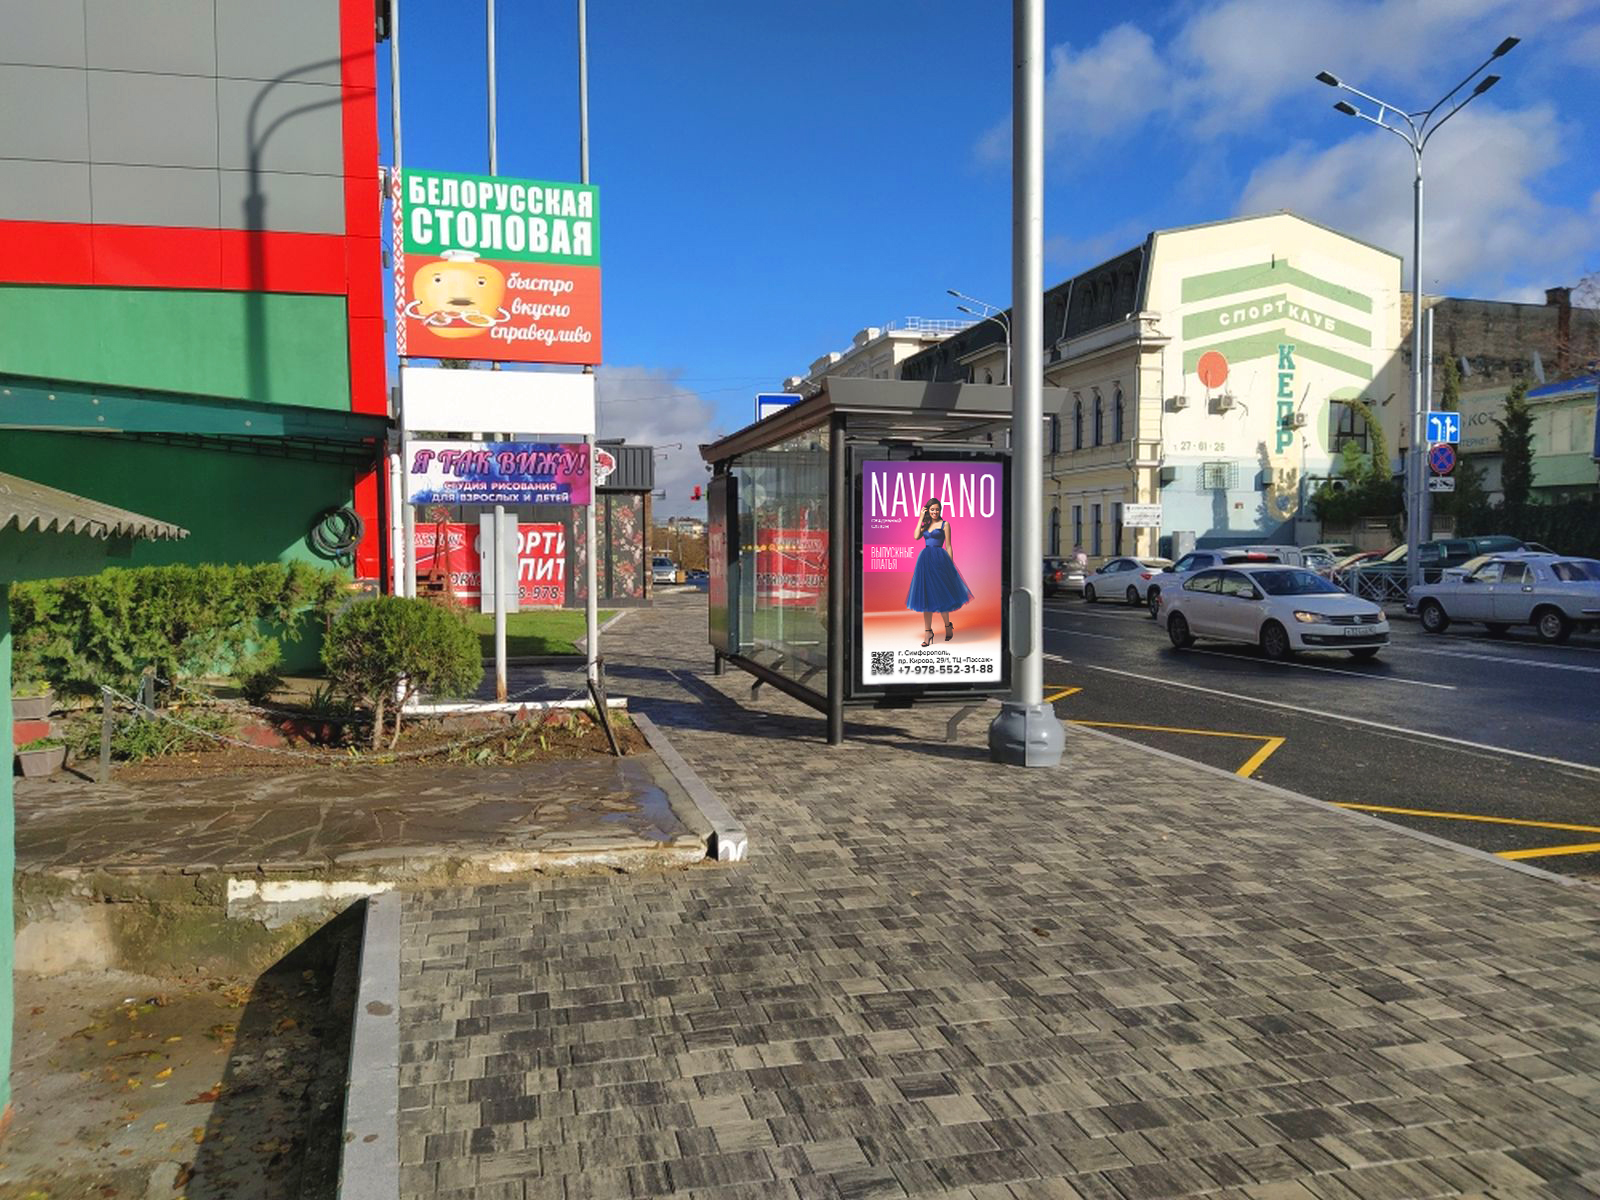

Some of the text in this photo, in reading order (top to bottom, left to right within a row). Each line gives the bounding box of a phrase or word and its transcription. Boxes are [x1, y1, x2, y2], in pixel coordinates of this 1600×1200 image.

[408, 175, 593, 218] БЕЛОРУССКАЯ
[411, 207, 593, 256] СТОЛОВАЯ
[507, 272, 574, 296] быстро
[511, 297, 570, 320] вкусно
[490, 325, 592, 346] справедливо
[411, 449, 435, 474] Я
[438, 449, 492, 477] ТАК
[496, 451, 587, 476] ВИЖУ!
[444, 481, 557, 491] СТУДИЯ РИСОВАНИЯ
[871, 472, 995, 518] NAVIANO
[432, 493, 454, 502] ДЛЯ
[460, 493, 519, 502] ВЗРОСЛЫХ
[535, 492, 569, 503] ДЕТЕЙ
[871, 546, 914, 558] ВЫПУСКНЫЕ
[871, 559, 898, 570] ПЛАТЬЯ
[898, 664, 994, 675] +7-978-552-31-88
